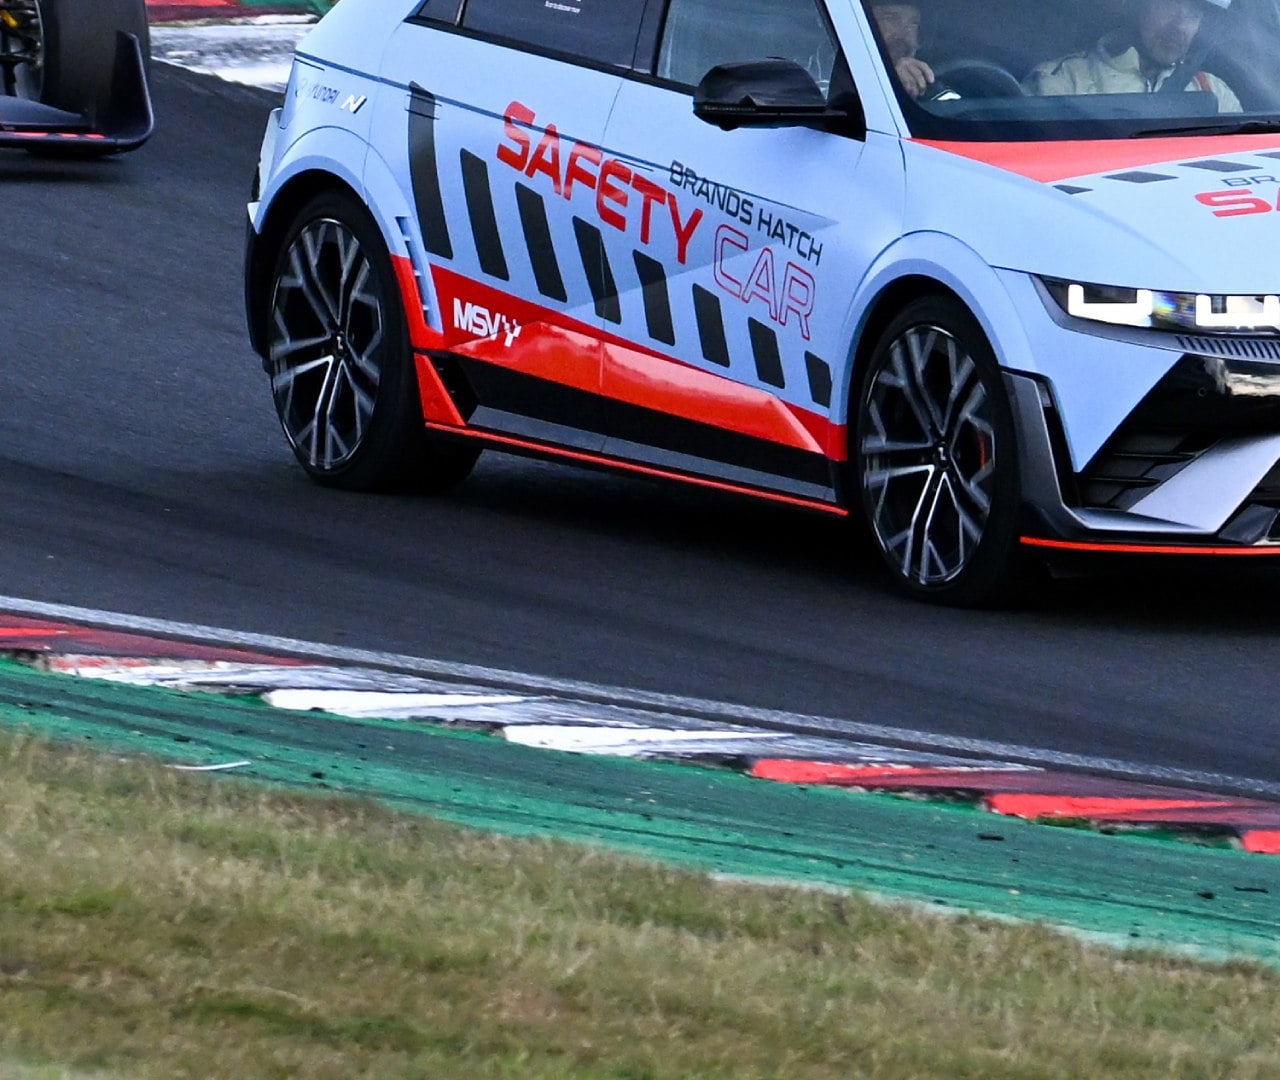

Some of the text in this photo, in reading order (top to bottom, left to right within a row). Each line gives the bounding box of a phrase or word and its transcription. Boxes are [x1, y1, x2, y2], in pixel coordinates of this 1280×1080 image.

[496, 100, 704, 266] SAFETY
[669, 159, 824, 267] BRANDS HATCH
[713, 223, 815, 342] CAR
